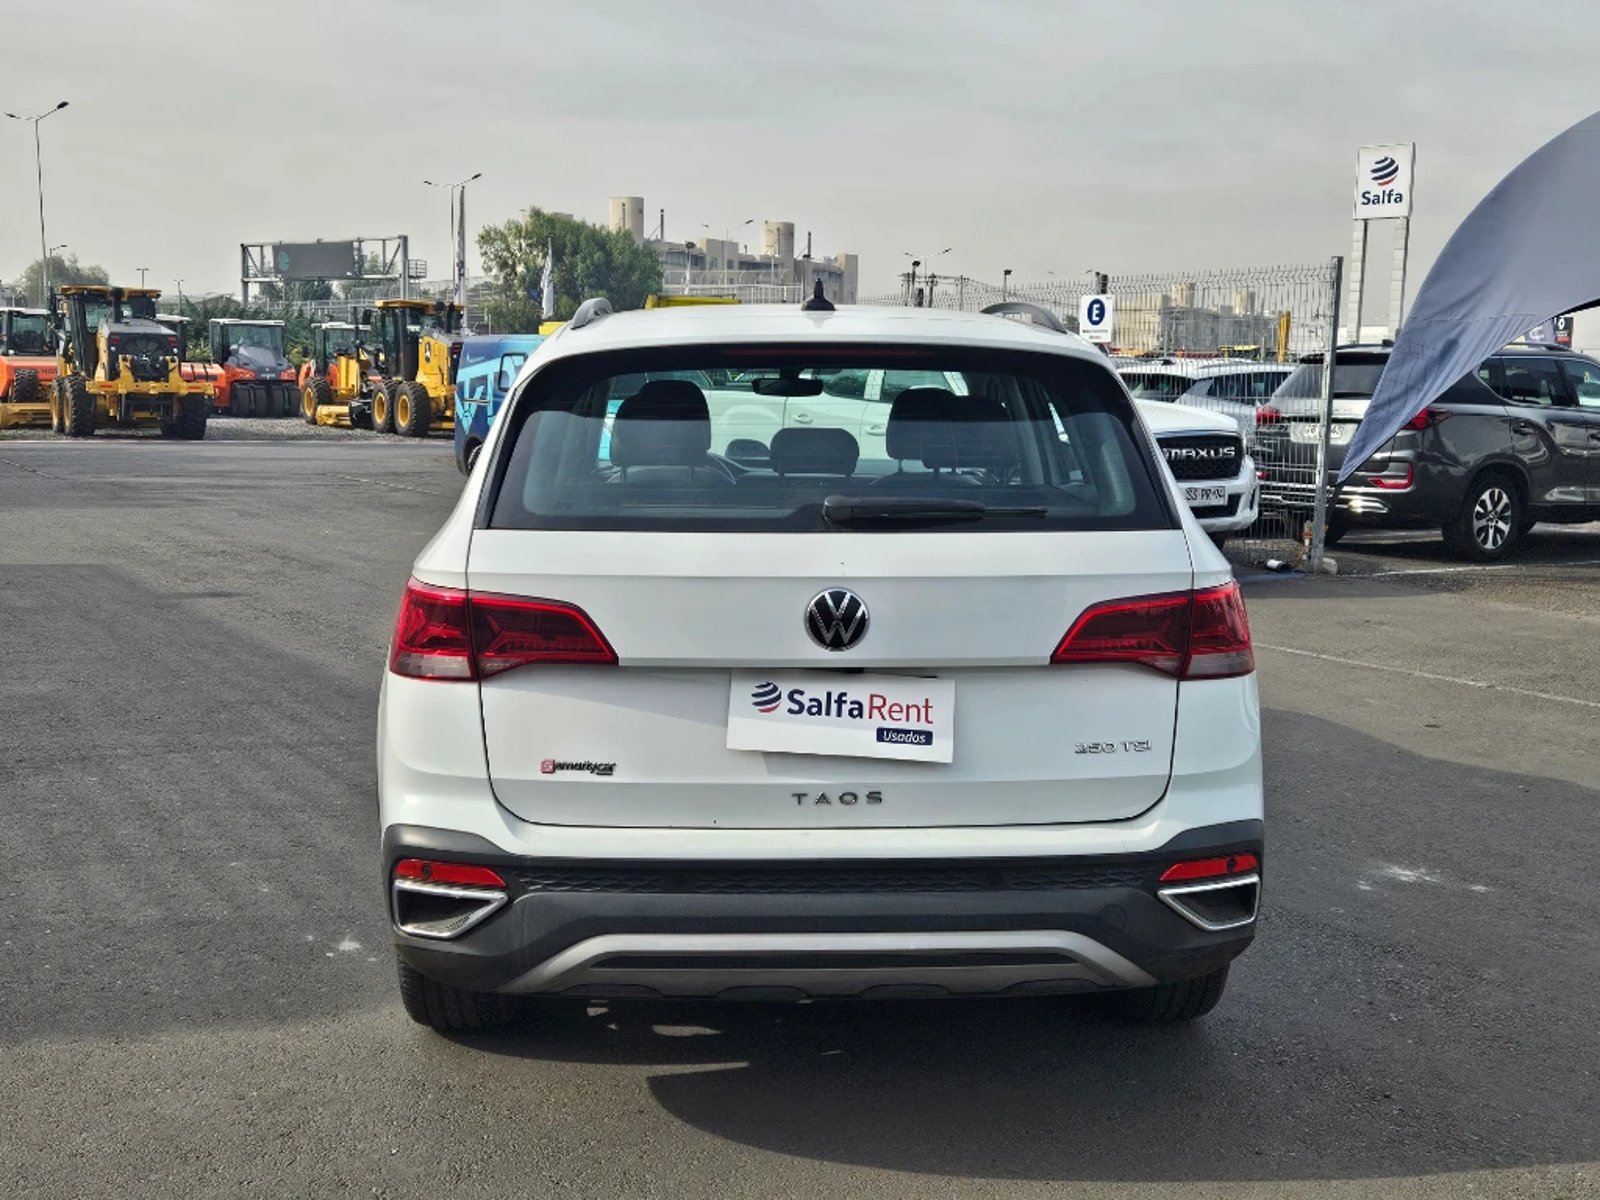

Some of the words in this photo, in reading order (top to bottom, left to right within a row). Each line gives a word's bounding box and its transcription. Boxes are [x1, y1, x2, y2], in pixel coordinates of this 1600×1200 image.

[1361, 189, 1403, 205] Salfa
[1092, 304, 1100, 321] E
[787, 688, 934, 724] SalfaRent
[882, 729, 927, 744] Usados
[1120, 740, 1151, 753] TSI
[792, 791, 883, 806] TAOS
